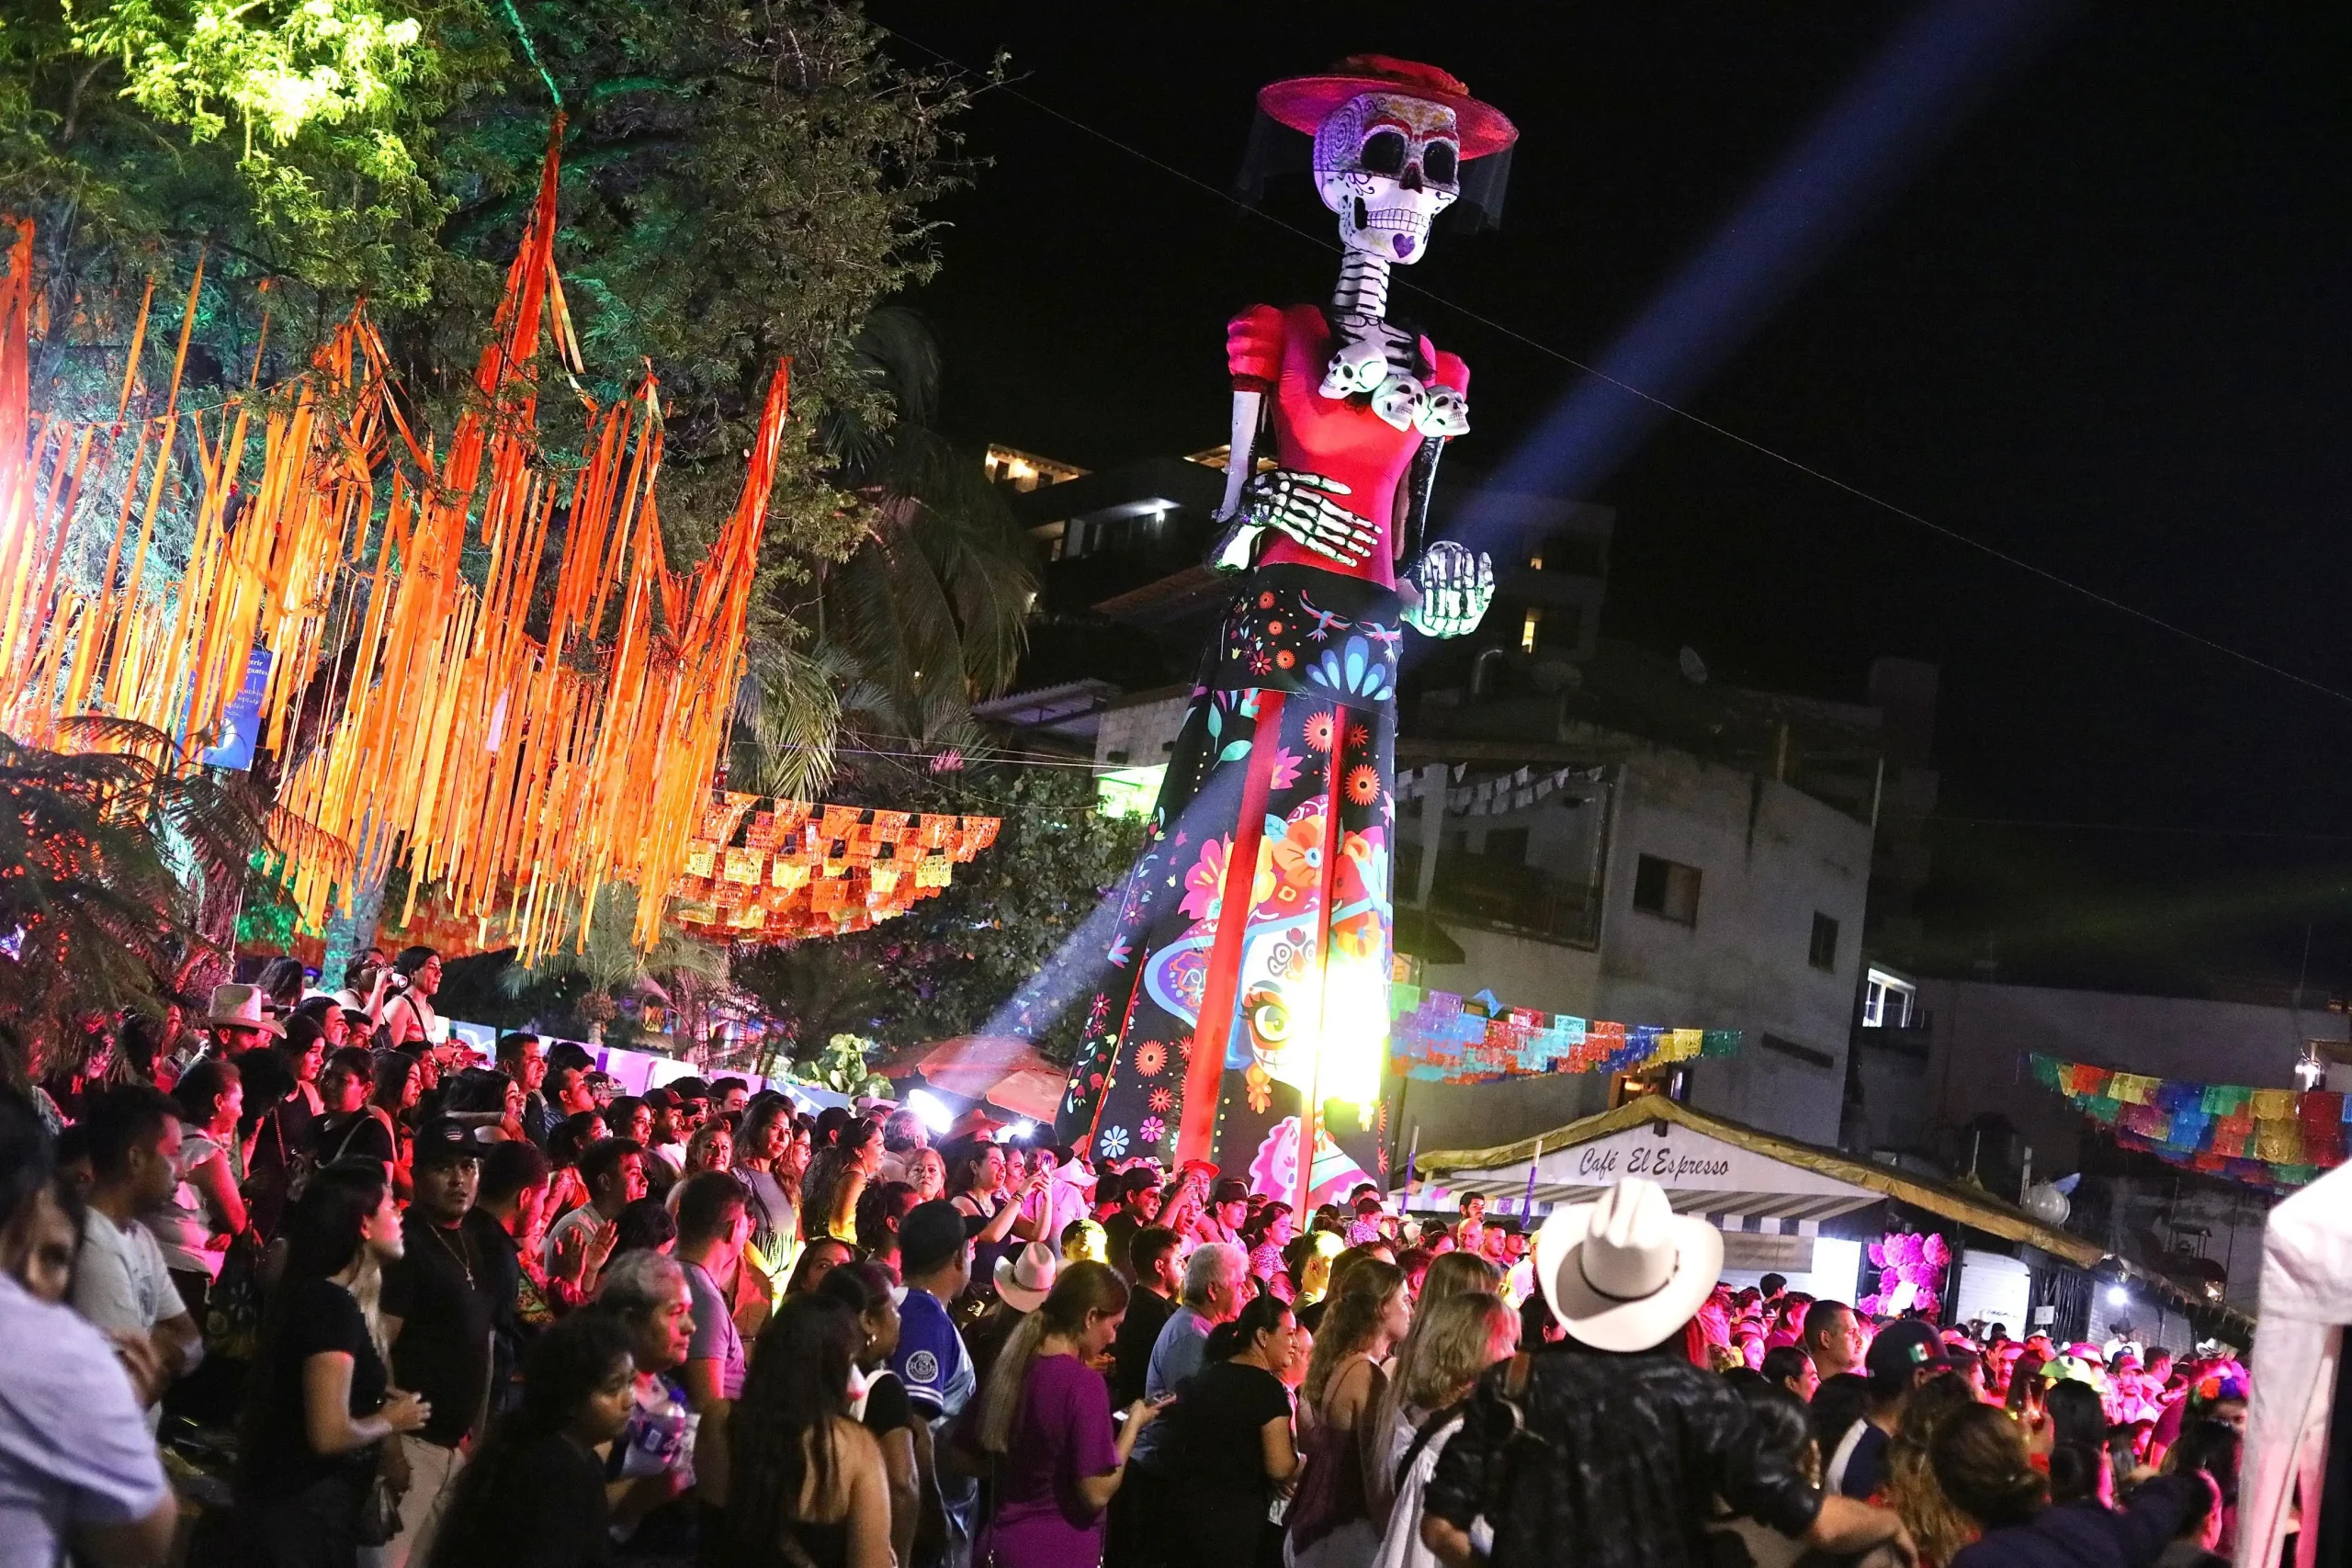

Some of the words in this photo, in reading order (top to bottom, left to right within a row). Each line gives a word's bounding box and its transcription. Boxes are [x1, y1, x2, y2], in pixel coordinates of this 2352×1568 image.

[1580, 1148, 1619, 1181] Café
[1627, 1147, 1651, 1173] El
[1653, 1148, 1729, 1181] Espresso
